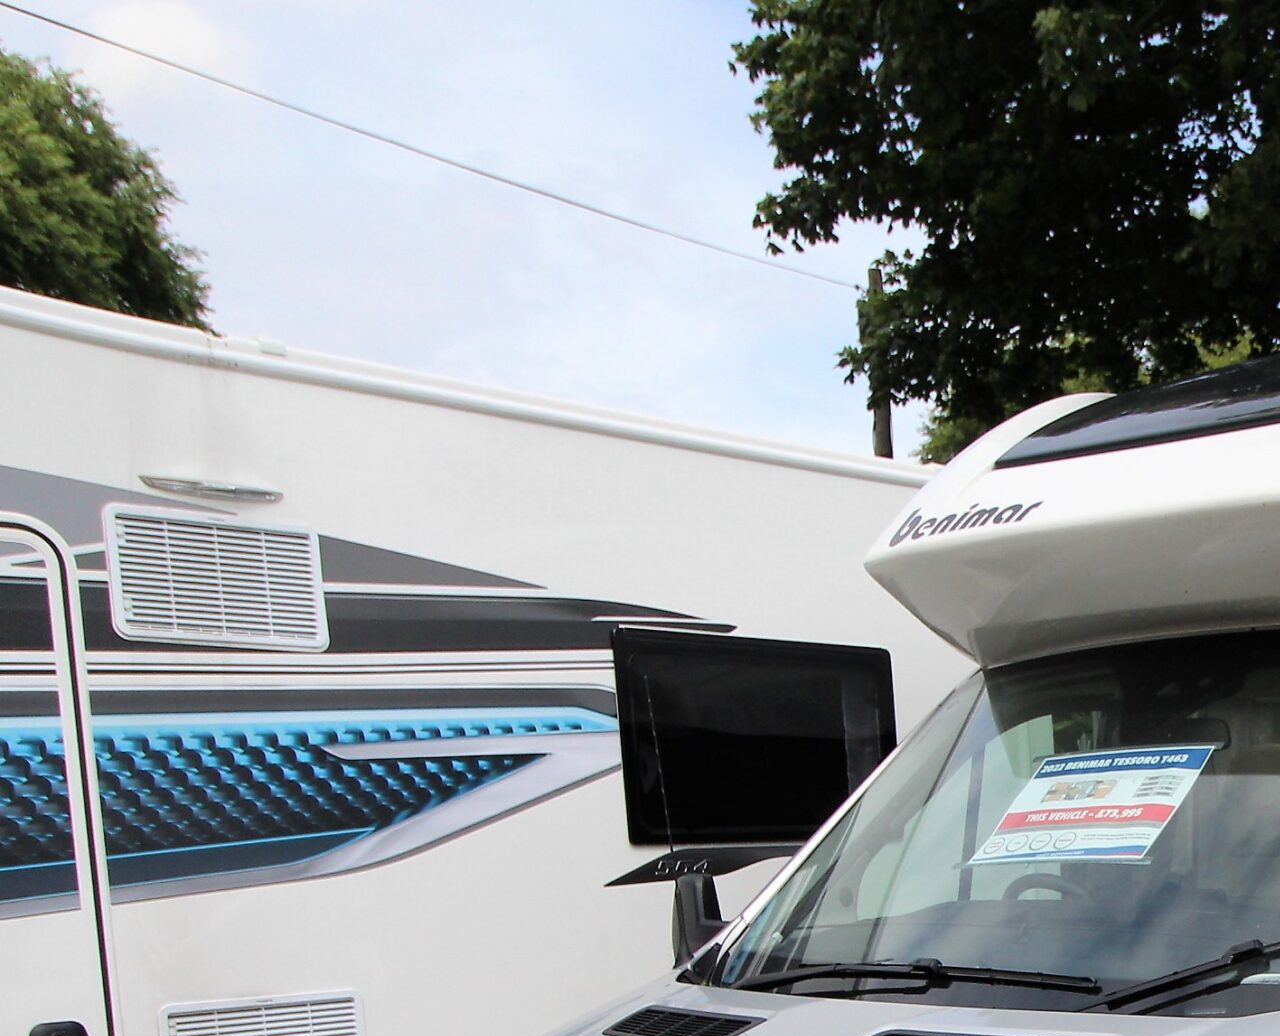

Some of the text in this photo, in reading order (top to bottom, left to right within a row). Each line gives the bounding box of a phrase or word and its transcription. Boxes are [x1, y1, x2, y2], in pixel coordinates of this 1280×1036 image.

[888, 500, 1044, 547] benimar
[1040, 754, 1189, 774] 2022 BENIMAR TESSORO T463
[1025, 813, 1049, 823] THIS
[1048, 810, 1088, 821] VEHICLE
[1094, 808, 1144, 819] £73,995
